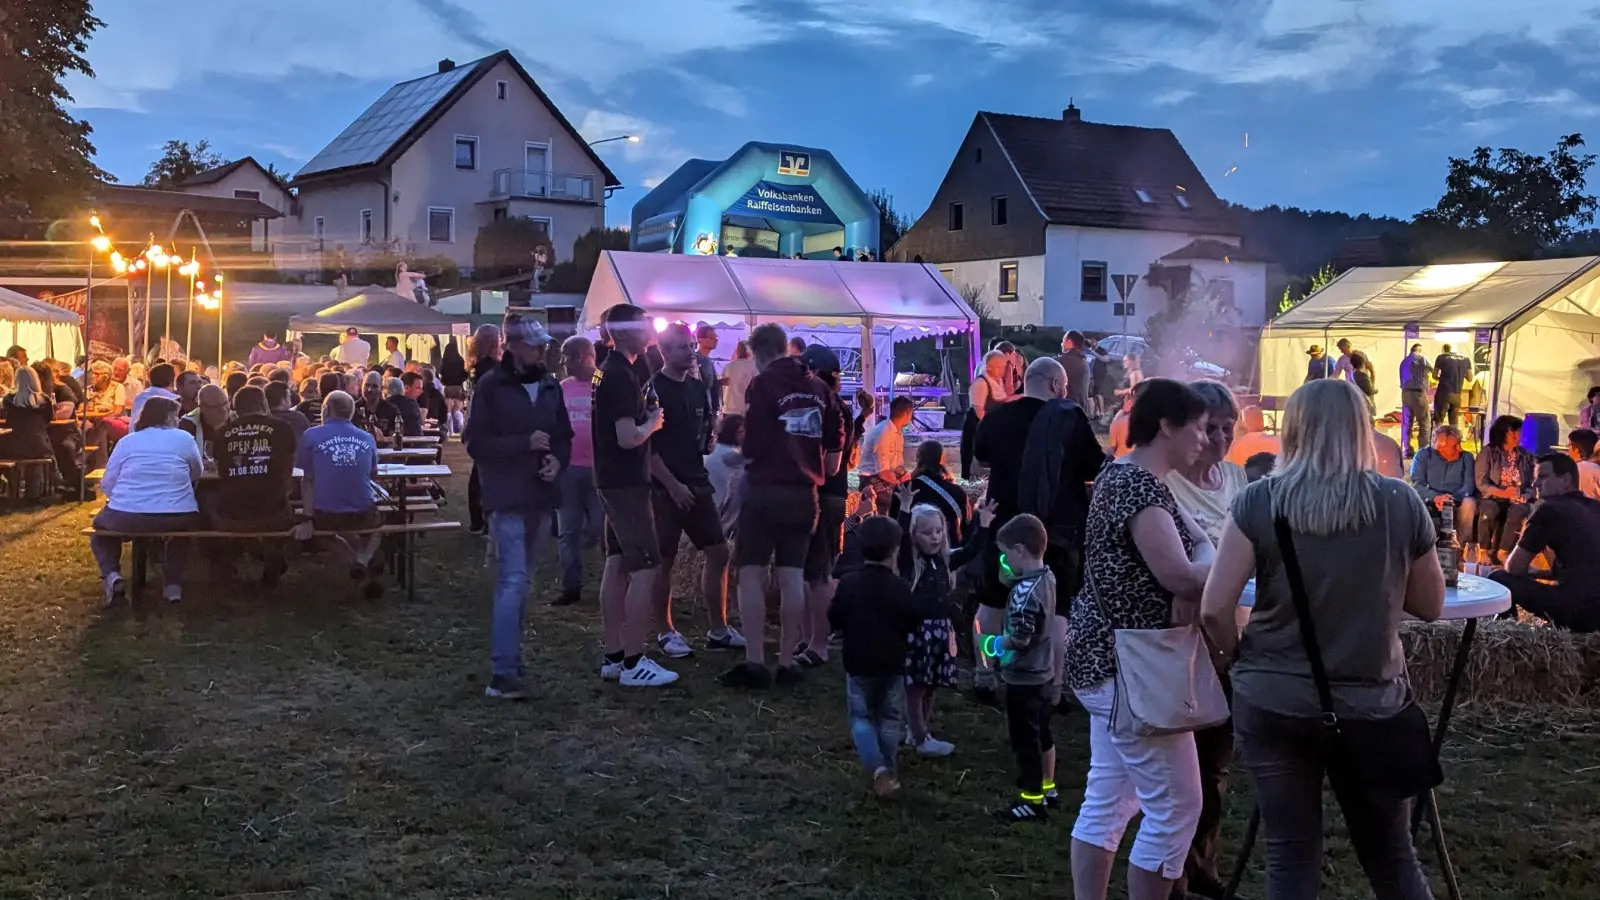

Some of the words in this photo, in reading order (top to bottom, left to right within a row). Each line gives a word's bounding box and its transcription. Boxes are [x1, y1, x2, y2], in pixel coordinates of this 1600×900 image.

[757, 188, 814, 203] Volksbanken
[747, 199, 822, 215] Raiffeisenbanken
[227, 440, 250, 452] OPEN
